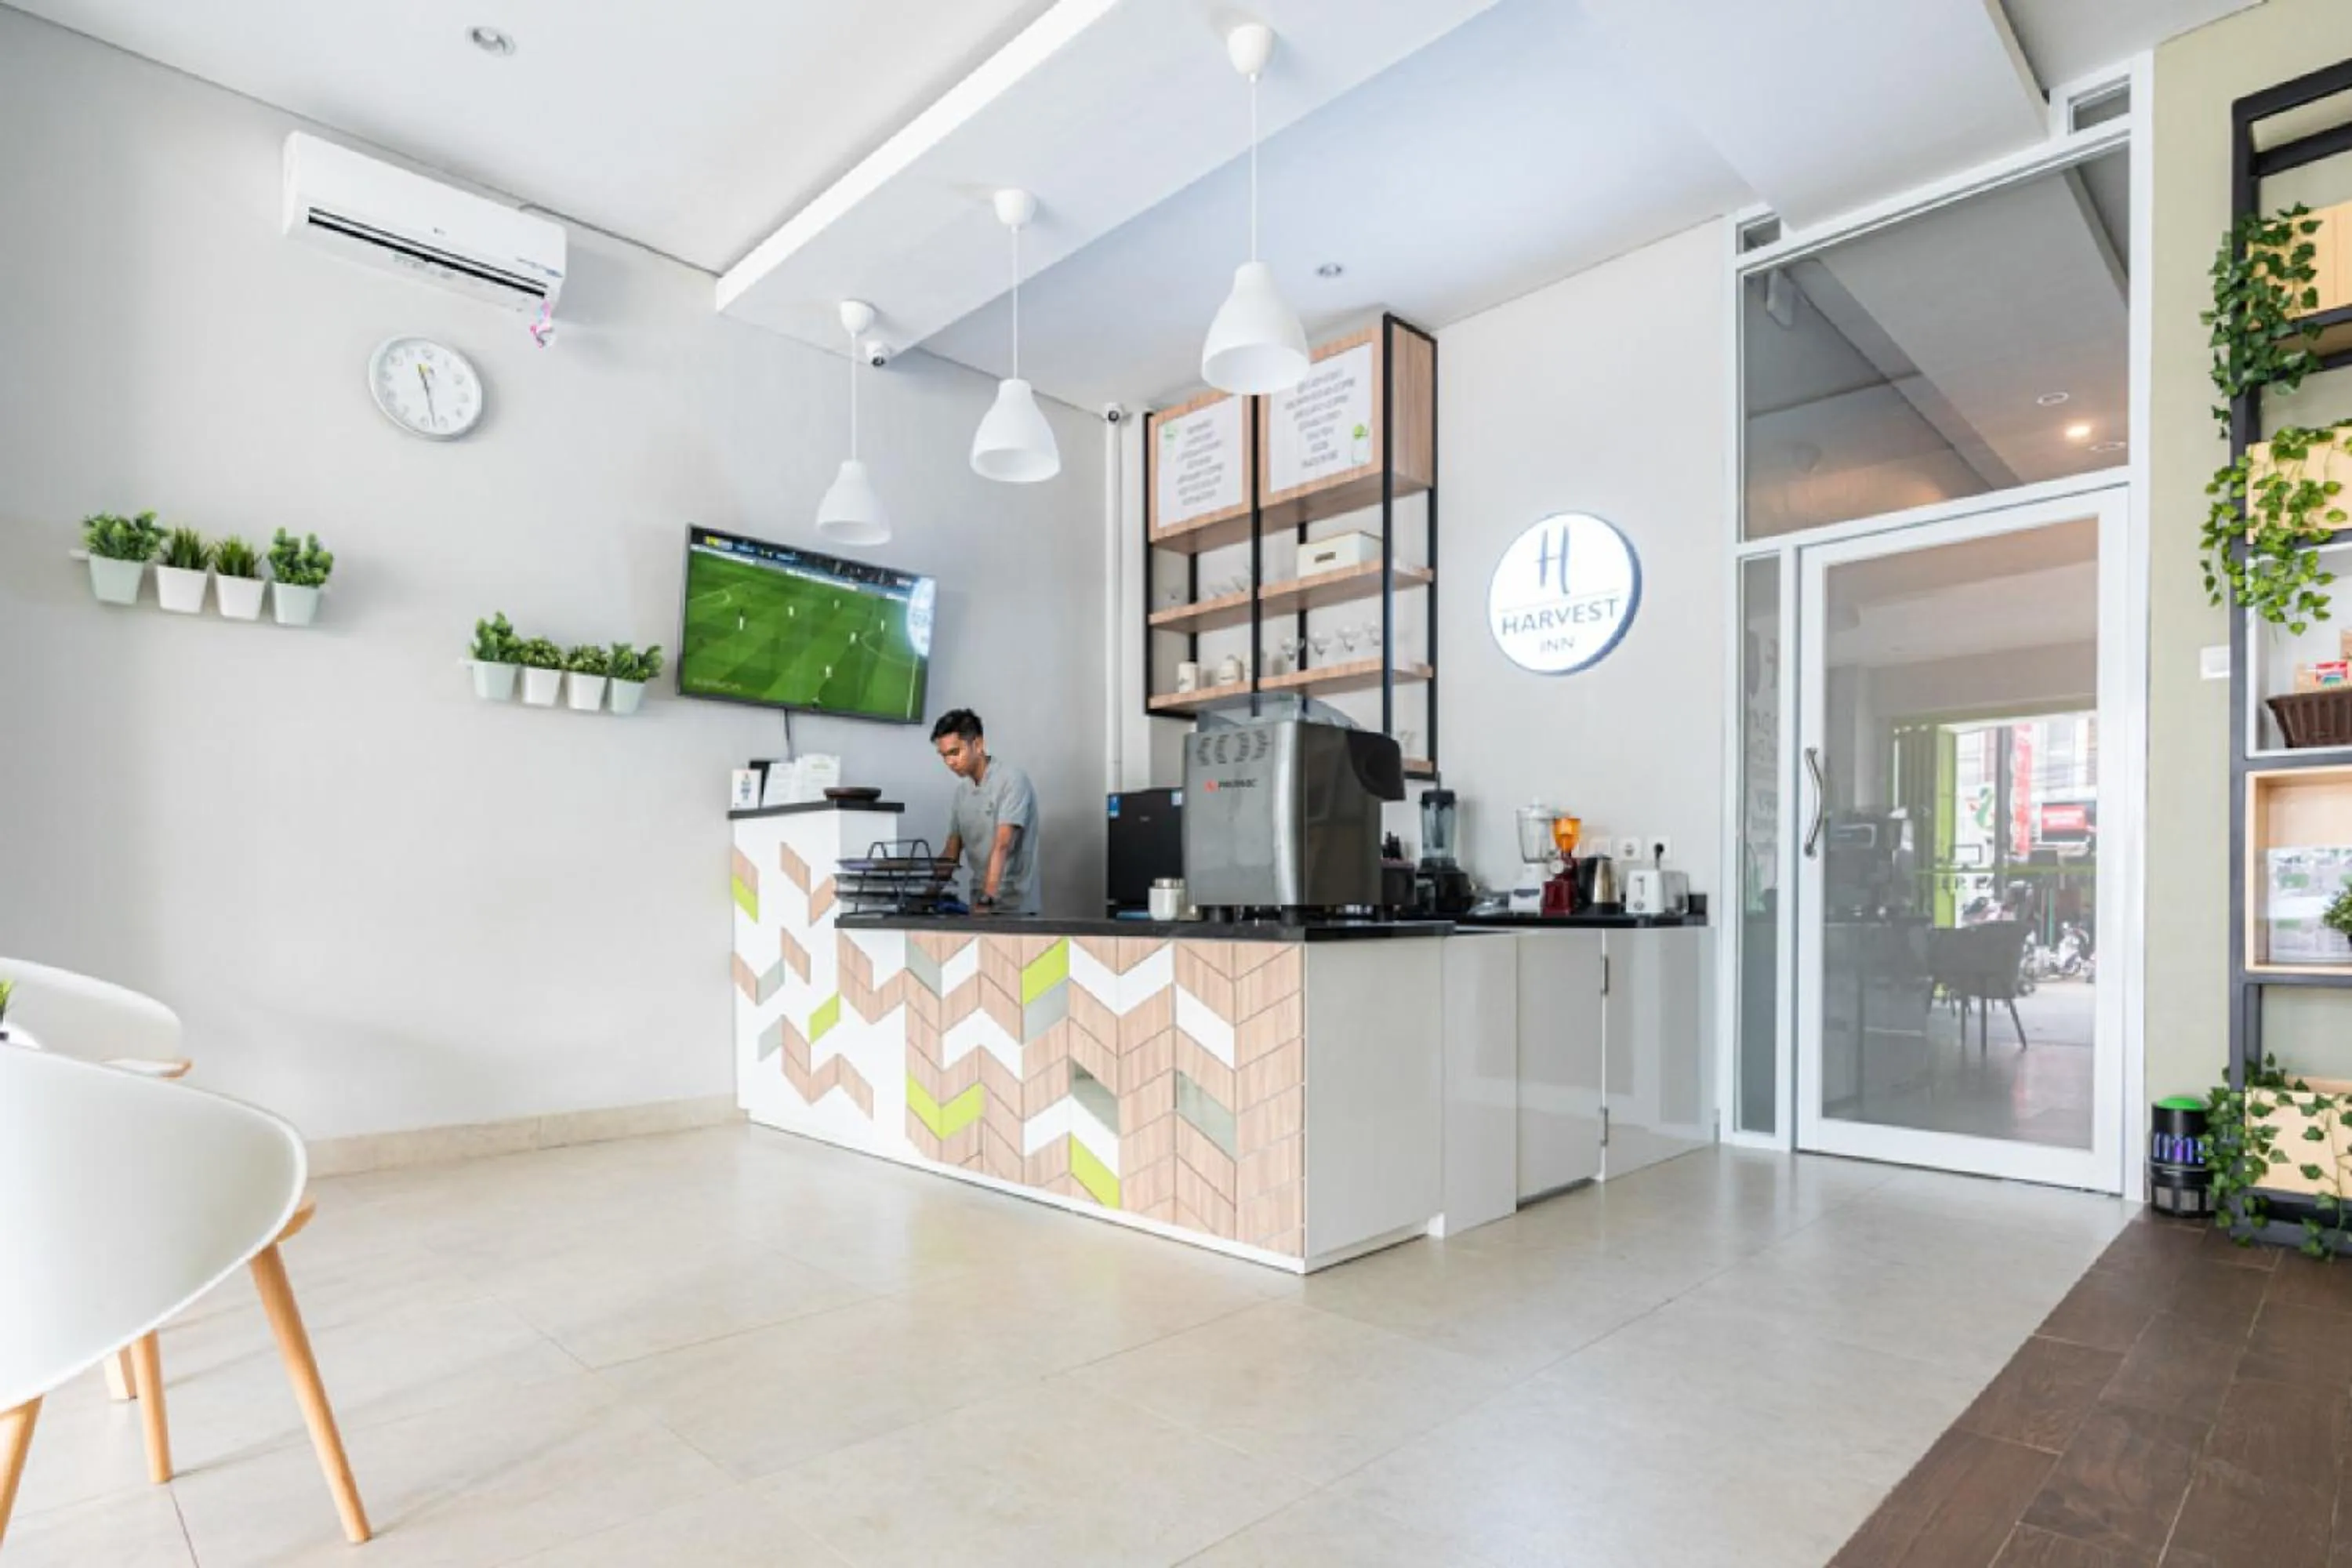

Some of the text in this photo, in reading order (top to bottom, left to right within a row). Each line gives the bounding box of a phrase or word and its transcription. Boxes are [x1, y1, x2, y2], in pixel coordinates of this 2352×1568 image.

[1534, 524, 1570, 594] H
[1501, 597, 1620, 636] HARVEST
[1540, 637, 1575, 652] INN
